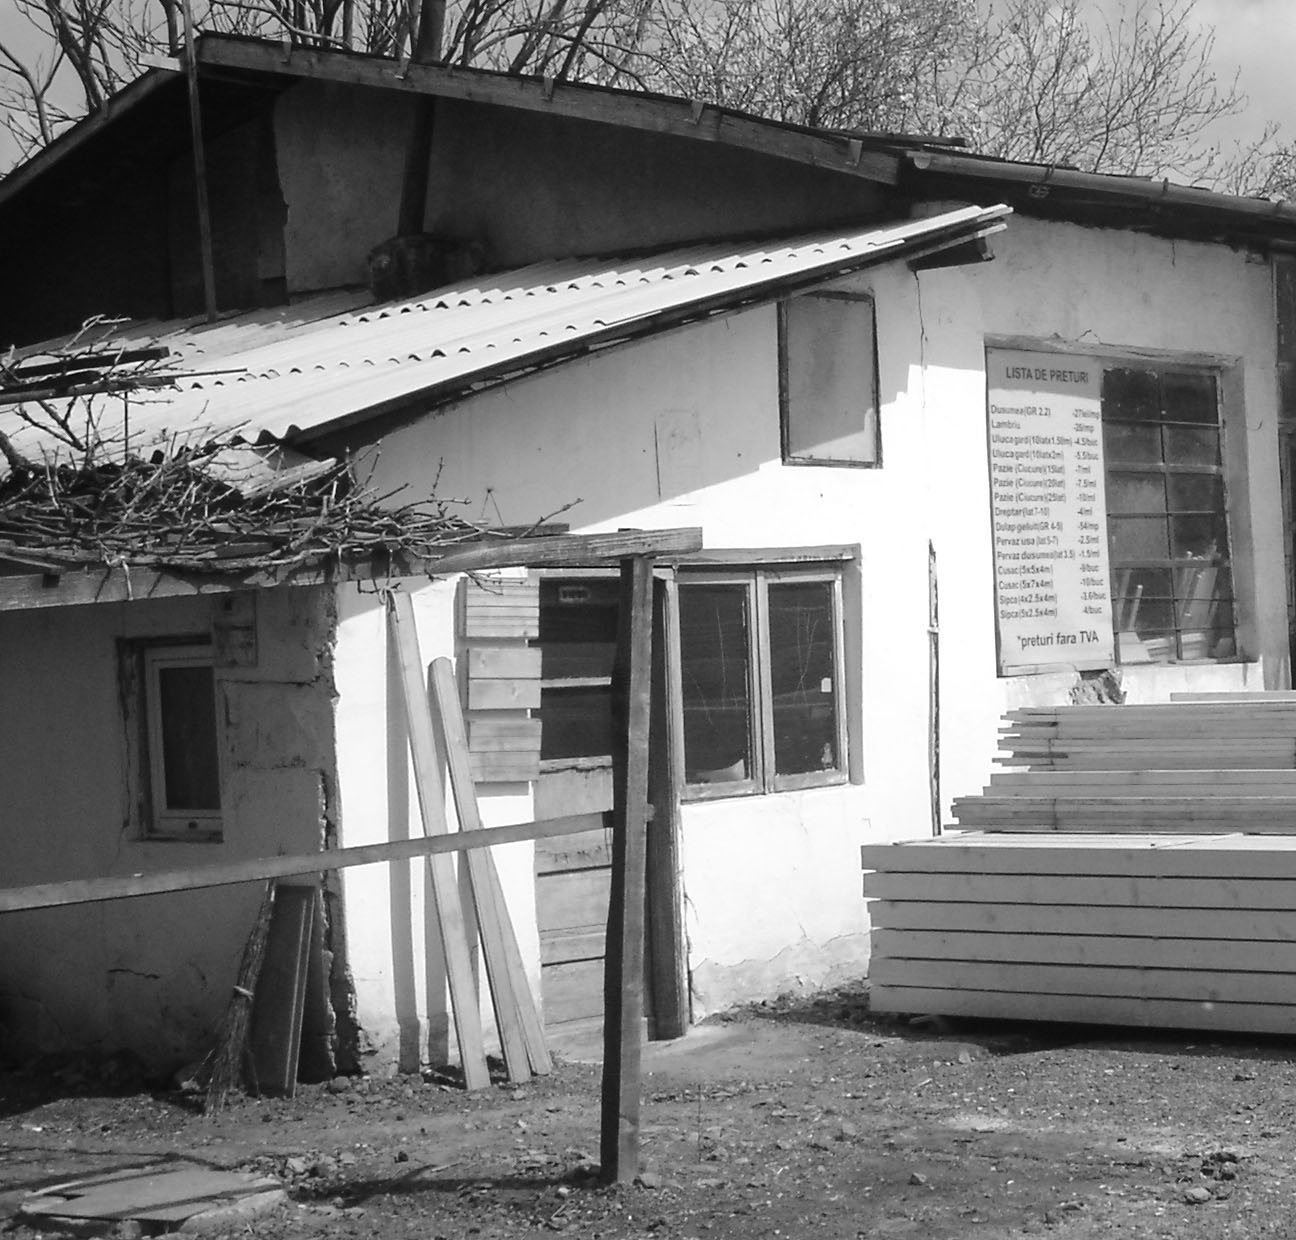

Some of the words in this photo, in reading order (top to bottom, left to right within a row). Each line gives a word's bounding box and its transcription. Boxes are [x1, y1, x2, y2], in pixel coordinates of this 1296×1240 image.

[1006, 366, 1033, 380] LISTA
[1034, 368, 1047, 381] DE
[1049, 369, 1088, 384] PRETURI
[1056, 631, 1077, 645] fara
[1080, 630, 1100, 643] TVA
